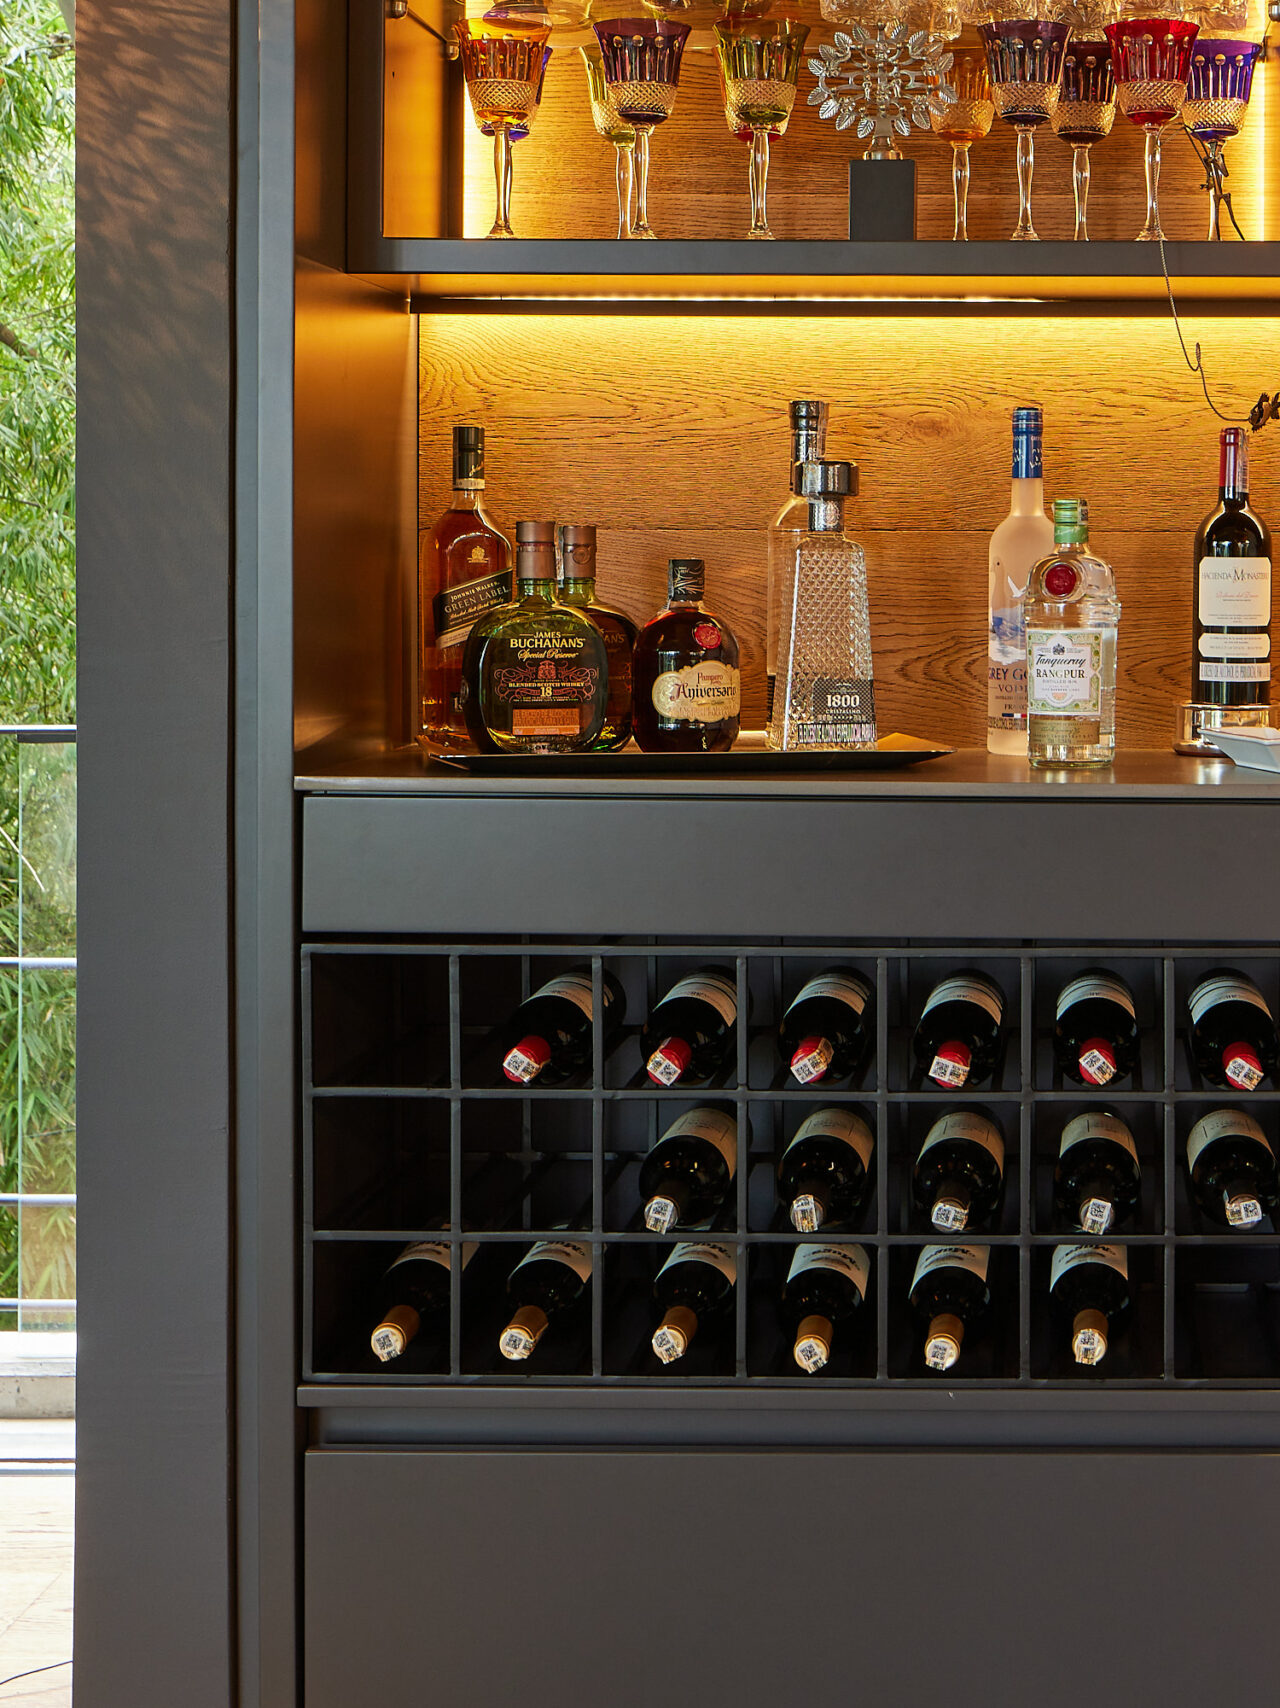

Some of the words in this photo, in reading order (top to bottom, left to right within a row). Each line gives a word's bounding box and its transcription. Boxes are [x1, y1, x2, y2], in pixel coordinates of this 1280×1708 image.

[444, 597, 476, 613] GREEN
[480, 586, 508, 601] LABEL
[510, 638, 584, 648] BUCHANAN'S
[517, 649, 545, 661] Special
[546, 648, 578, 659] Reserve
[1035, 654, 1086, 667] Tanqueray
[1036, 669, 1085, 678] RANGPUR
[540, 687, 553, 697] 18
[826, 694, 860, 708] 1800
